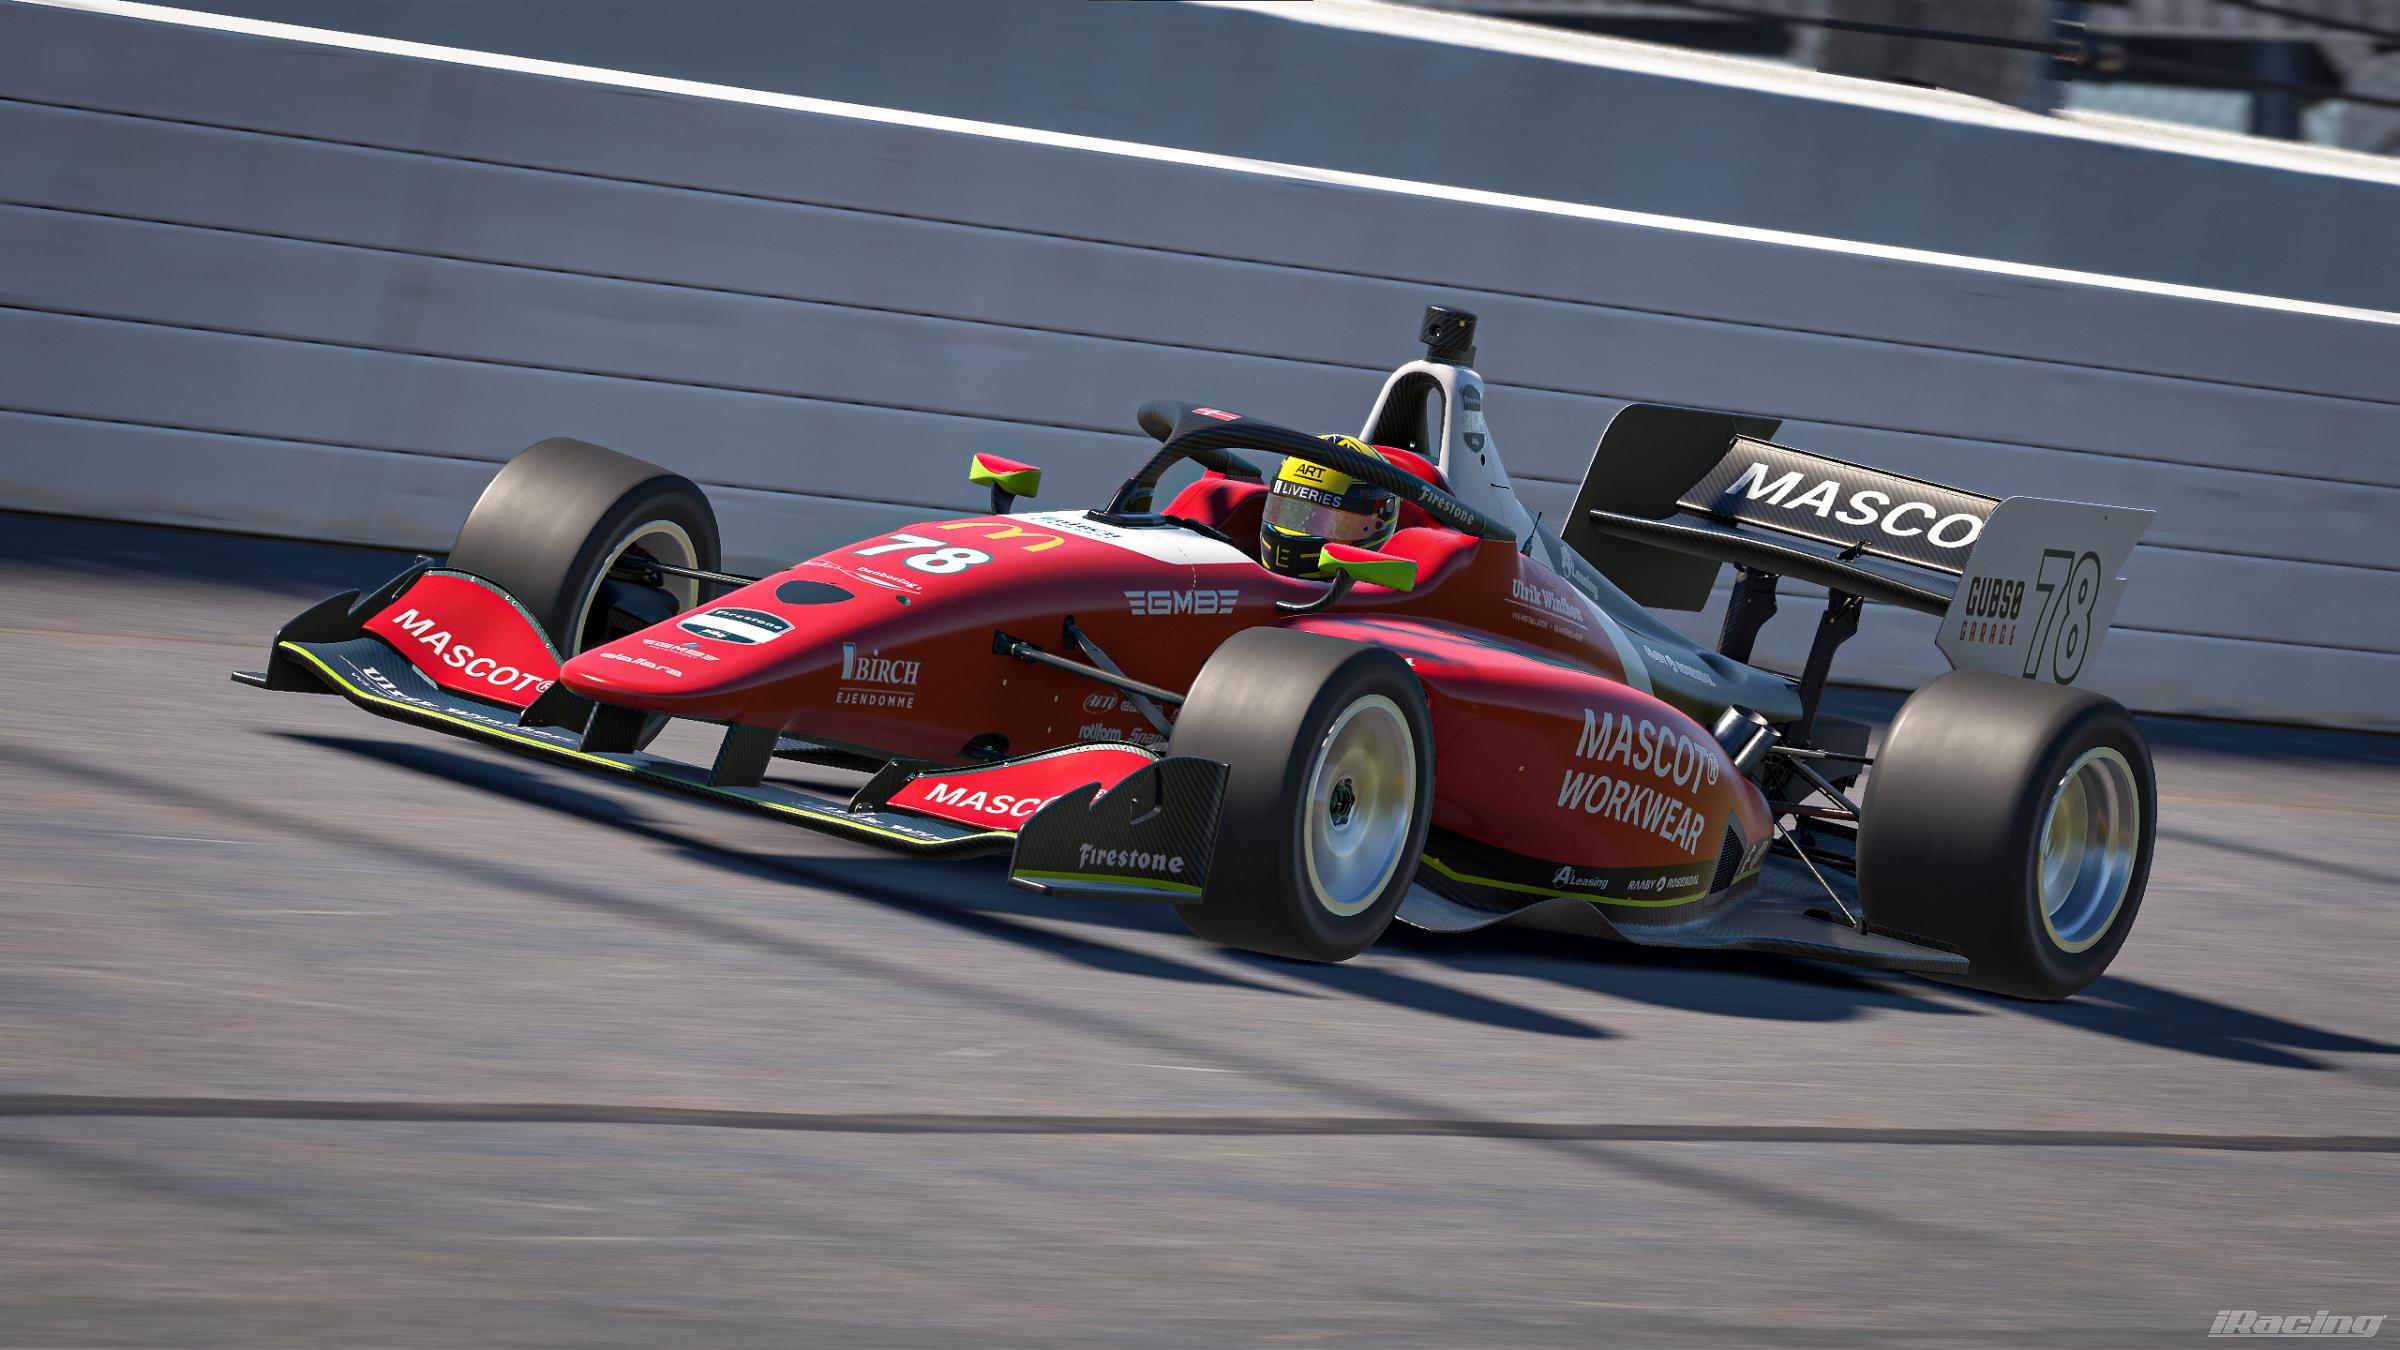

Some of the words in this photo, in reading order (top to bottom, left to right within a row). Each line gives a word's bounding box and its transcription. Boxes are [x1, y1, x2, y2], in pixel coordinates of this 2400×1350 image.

[1295, 464, 1326, 478] ART
[1419, 485, 1474, 525] Firestone
[1725, 462, 1983, 548] MASCO
[851, 533, 994, 574] 78
[715, 610, 783, 630] Firestone
[1959, 620, 2016, 646] GARAGE
[2023, 549, 2101, 685] 78
[924, 783, 1063, 817] MASC
[1557, 769, 1705, 855] WORKWEAR
[1079, 843, 1184, 873] Firestone
